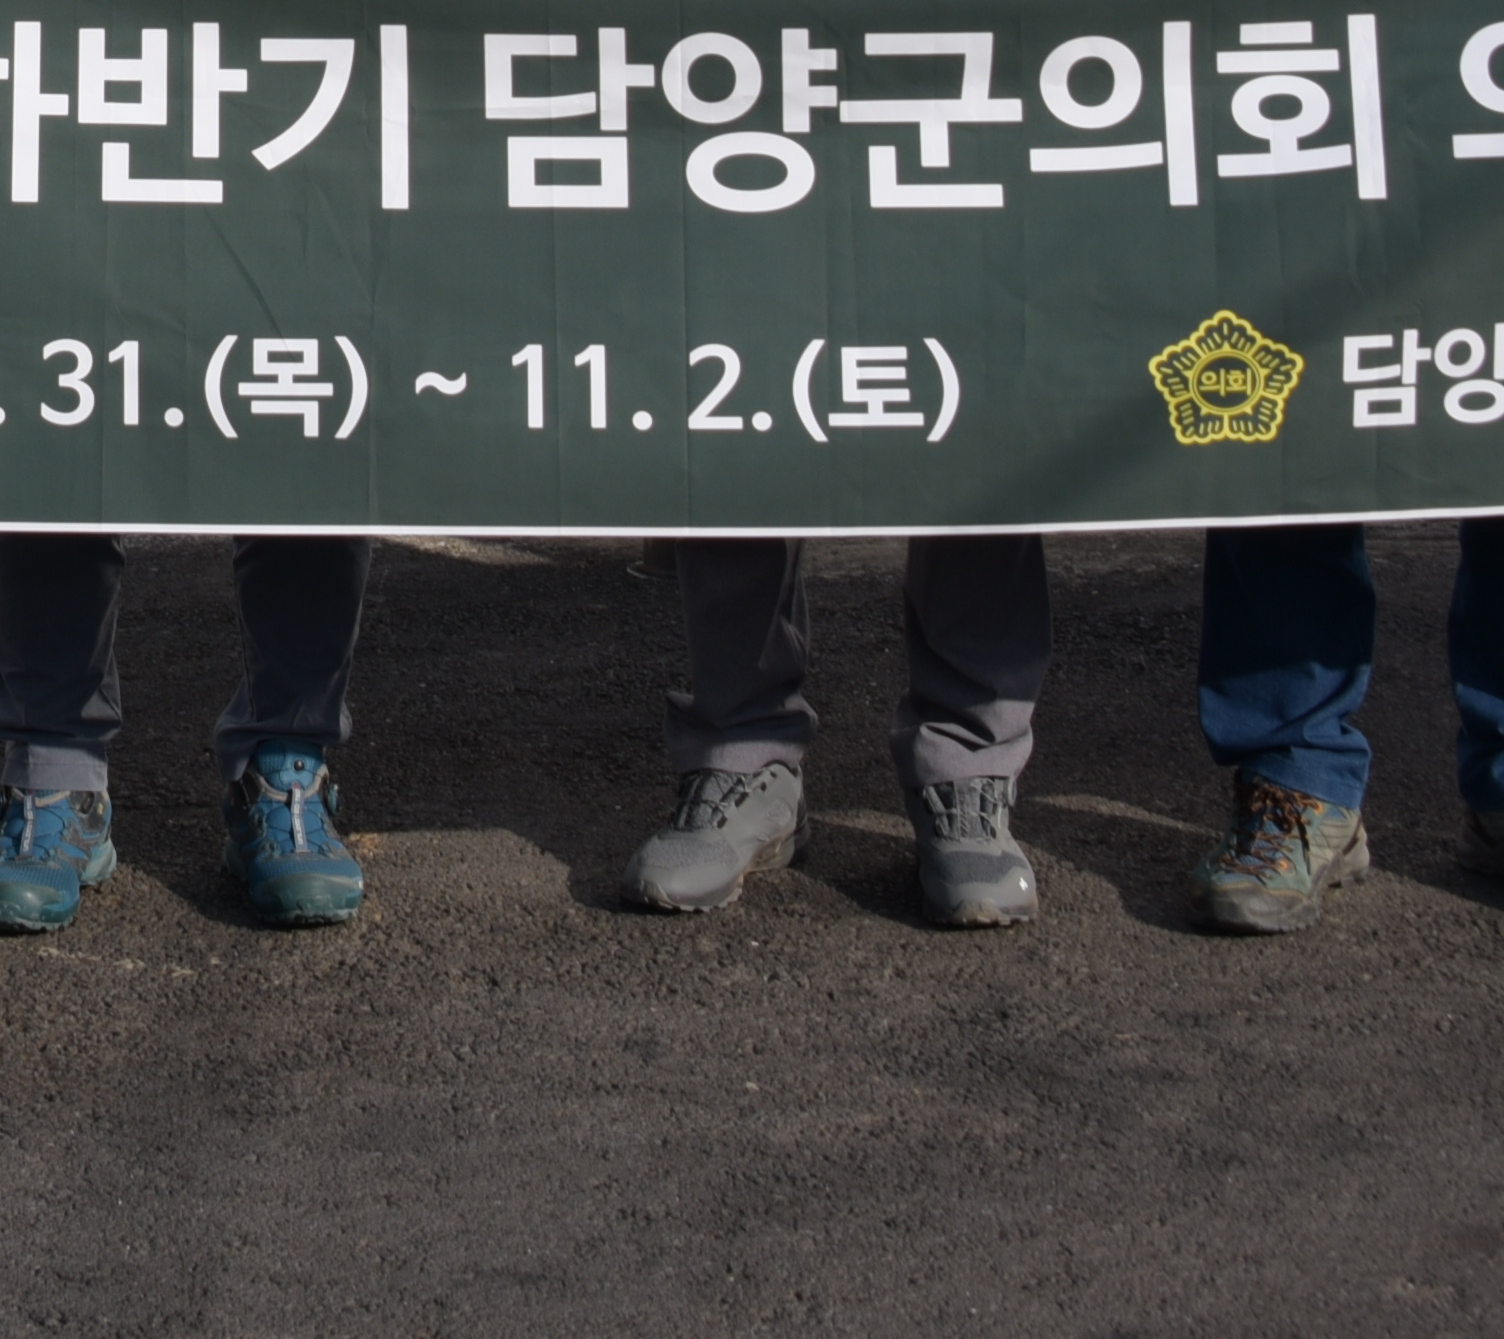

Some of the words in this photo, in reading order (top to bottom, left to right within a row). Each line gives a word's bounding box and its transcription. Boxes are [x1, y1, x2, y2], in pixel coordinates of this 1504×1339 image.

[482, 12, 1388, 213] 담양군의회
[40, 334, 369, 439] 31.(목)
[511, 343, 653, 431] 11.
[687, 337, 960, 443] 2.(토)
[1199, 368, 1252, 397] 의회
